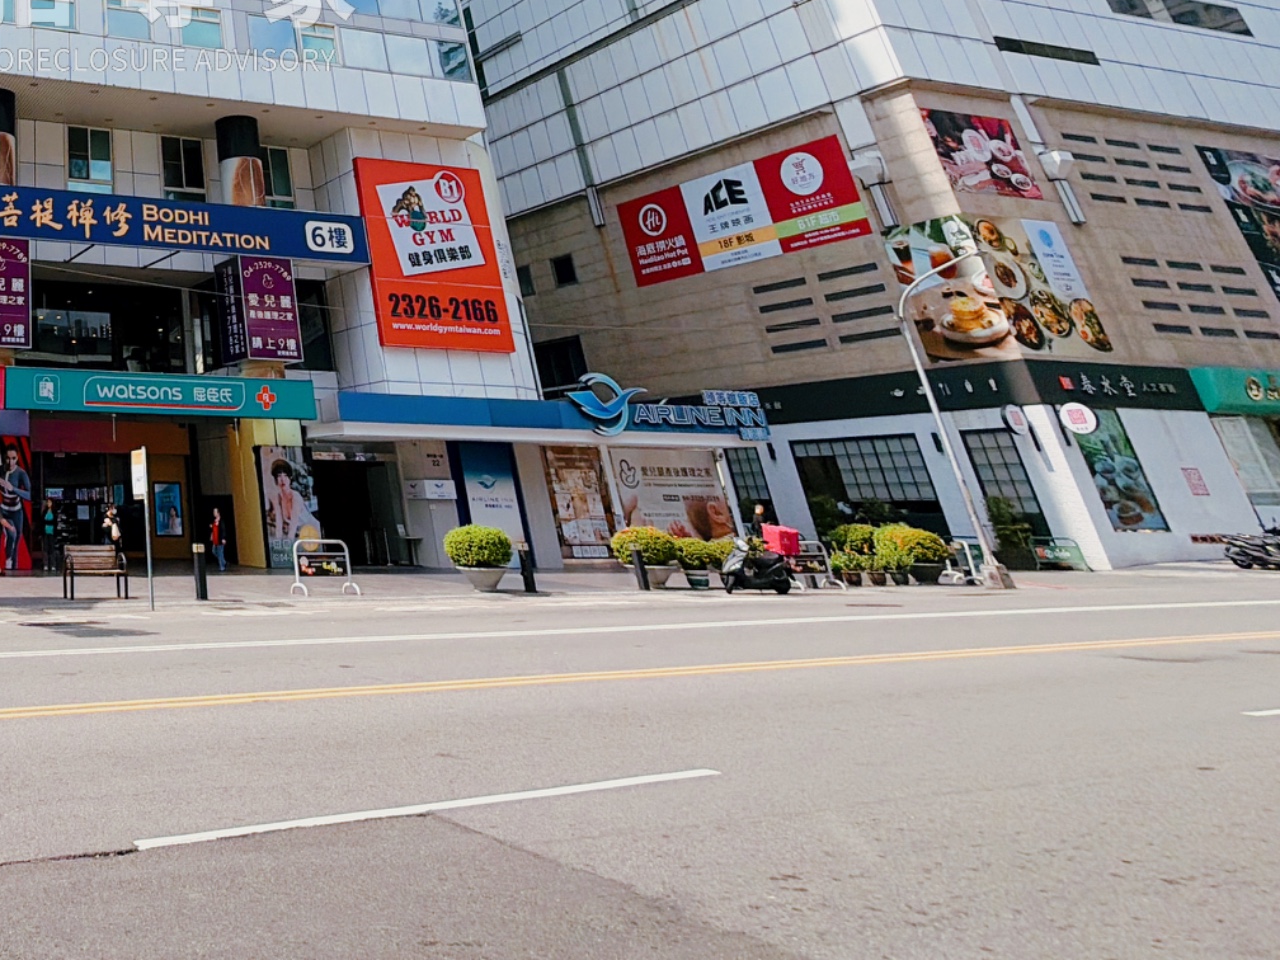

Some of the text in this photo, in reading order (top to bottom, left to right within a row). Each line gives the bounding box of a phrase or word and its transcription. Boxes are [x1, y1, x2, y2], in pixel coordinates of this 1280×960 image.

[439, 178, 461, 199] B1
[704, 179, 748, 215] ACE
[143, 205, 209, 227] BODHI
[646, 211, 661, 229] Hi
[797, 216, 816, 230] B1F
[144, 224, 270, 251] MEDITATION
[311, 227, 347, 249] 6樓
[412, 228, 455, 246] GYM
[718, 238, 734, 249] 18F
[408, 246, 473, 268] 健身俱樂部
[388, 292, 498, 323] 2326-2166
[392, 321, 501, 337] www.worldgymtaiwan.com
[97, 383, 233, 403] watsons 屈臣氏
[1080, 372, 1137, 397] 春水堂
[635, 404, 766, 427] AIRLINE INN
